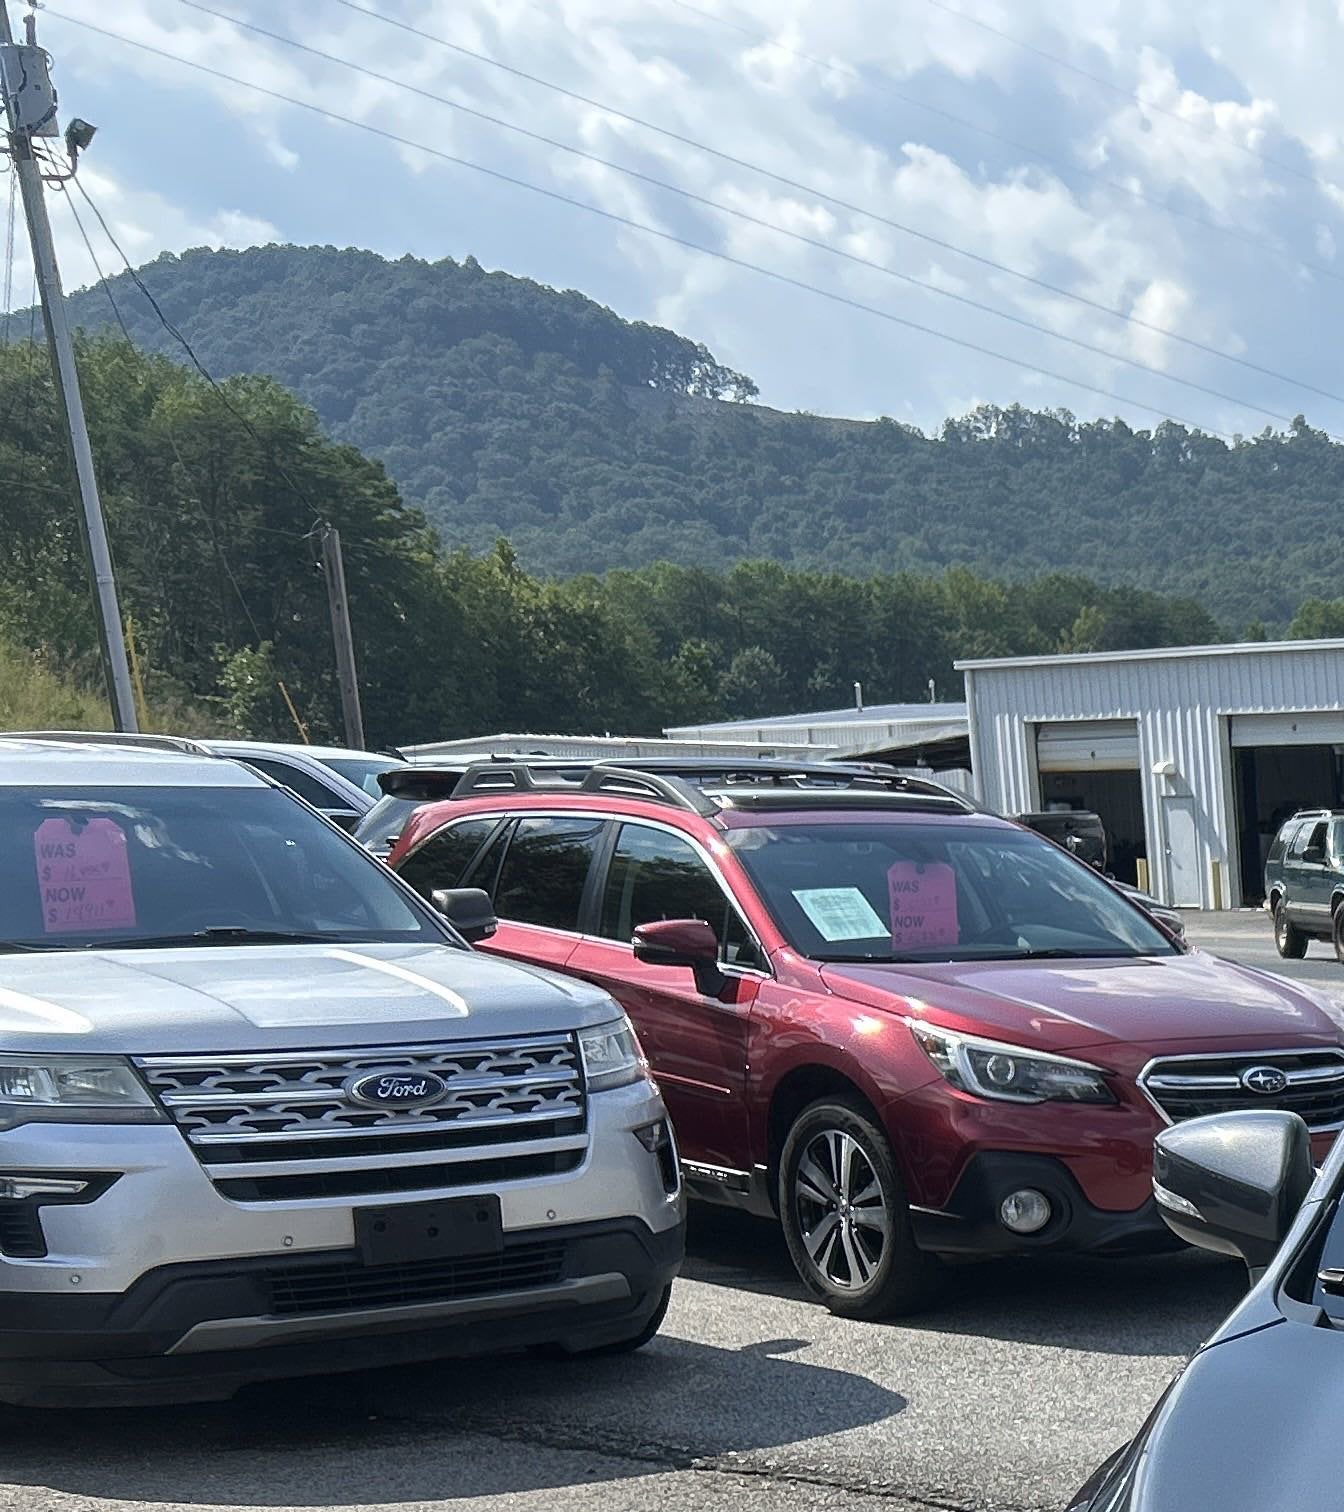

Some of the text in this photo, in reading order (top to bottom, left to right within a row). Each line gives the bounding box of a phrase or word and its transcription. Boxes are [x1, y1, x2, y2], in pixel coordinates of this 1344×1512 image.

[40, 843, 76, 859] WAS
[892, 879, 919, 893] WAS
[46, 887, 86, 903] NOW
[894, 915, 925, 929] NOW
[377, 1077, 428, 1098] Ford
